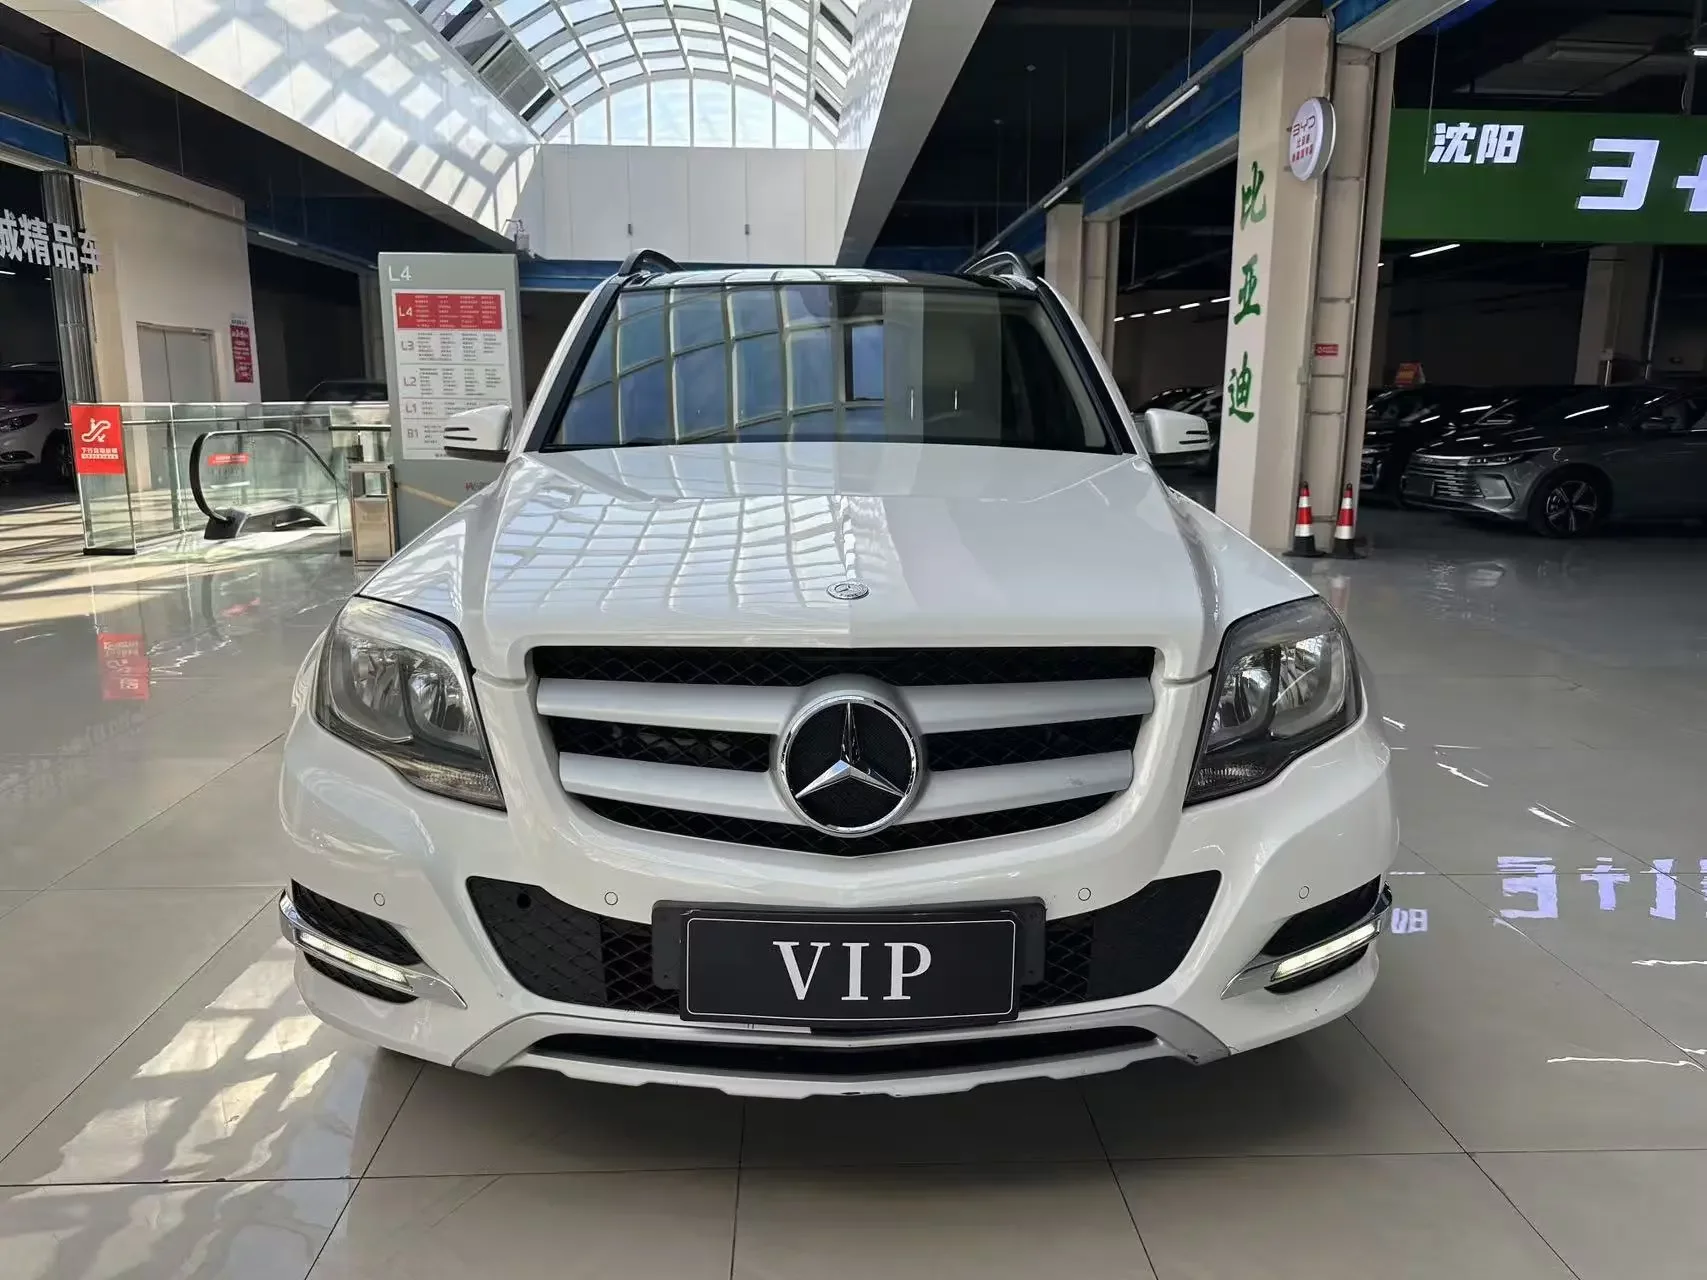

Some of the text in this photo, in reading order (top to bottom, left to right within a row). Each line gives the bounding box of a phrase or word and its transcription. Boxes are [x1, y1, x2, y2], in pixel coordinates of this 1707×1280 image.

[1428, 122, 1524, 164] 沈阳
[388, 264, 412, 282] L4
[1227, 160, 1267, 424] 比亚迪
[398, 304, 413, 317] L4
[401, 340, 415, 352] L3
[403, 375, 417, 387] L2
[405, 403, 417, 414] L1
[407, 428, 419, 439] B1
[772, 940, 932, 1001] VIP
